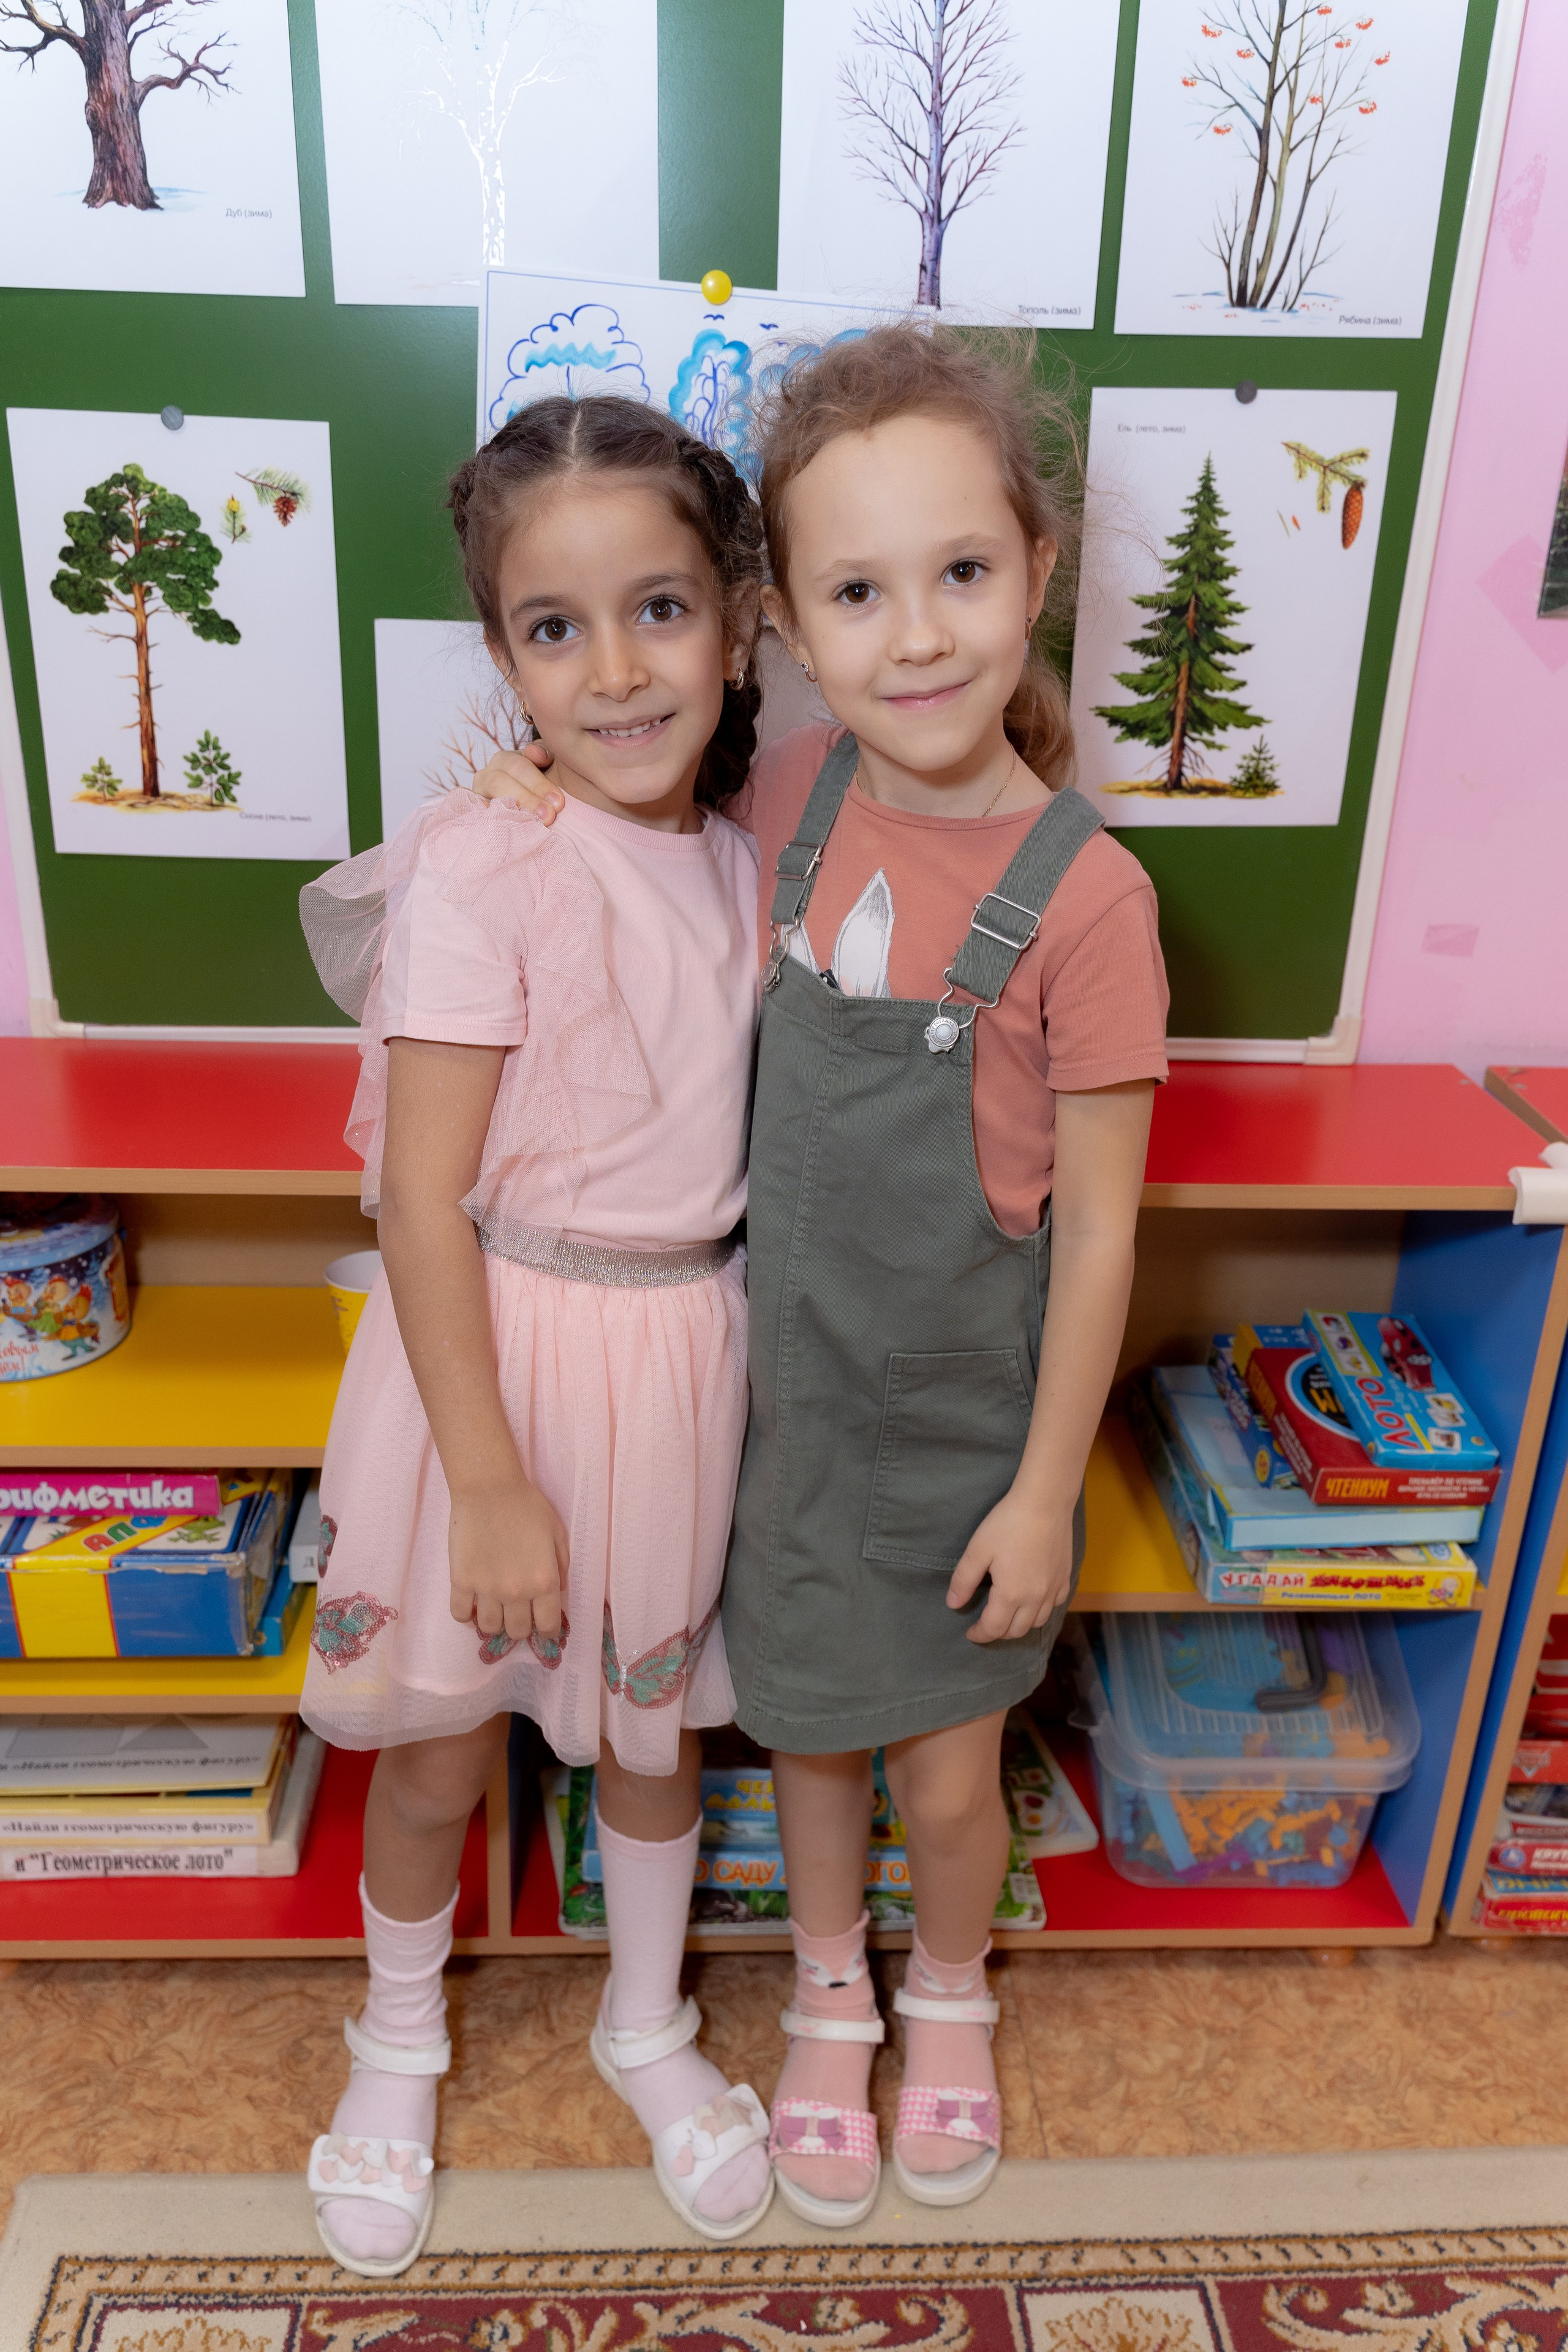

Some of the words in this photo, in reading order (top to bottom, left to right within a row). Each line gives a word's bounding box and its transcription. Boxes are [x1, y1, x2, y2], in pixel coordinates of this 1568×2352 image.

[225, 208, 243, 218] Дуб
[244, 209, 272, 219] (зима)
[1018, 305, 1049, 315] Тополь
[1051, 306, 1081, 315] (зима)
[1339, 315, 1371, 325] Рябина
[1373, 316, 1402, 325] (зима)
[1355, 1377, 1421, 1449] ЛОТО
[1221, 1572, 1306, 1587] УГАДАЙ
[2, 1820, 59, 1832] «Найди
[64, 1823, 187, 1833] геометрическую
[192, 1820, 254, 1833] фигуру»
[15, 1858, 26, 1872] и
[712, 1858, 779, 1887] САДУ
